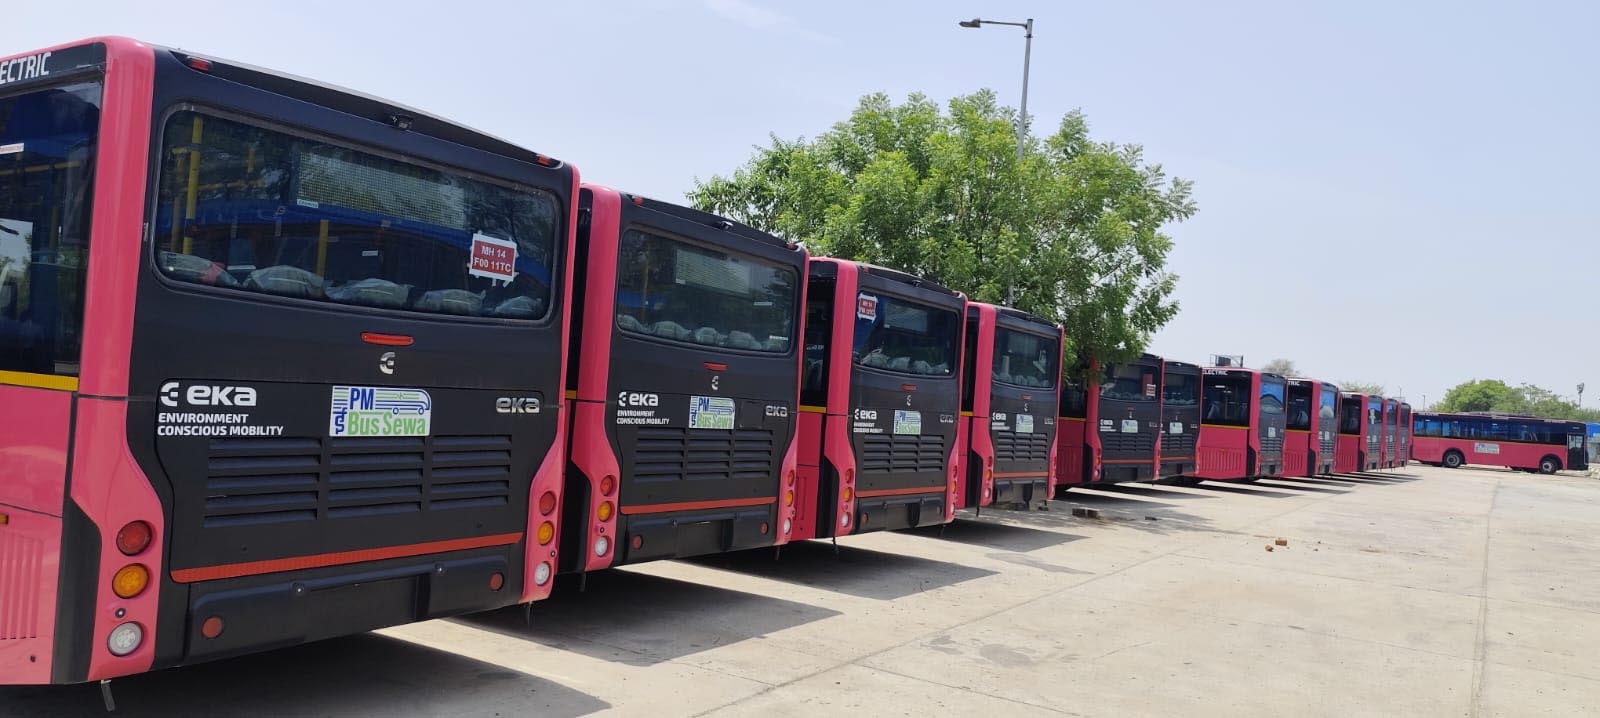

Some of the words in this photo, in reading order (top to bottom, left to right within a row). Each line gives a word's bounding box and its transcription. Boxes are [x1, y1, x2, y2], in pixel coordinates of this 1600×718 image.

[481, 245, 495, 256] MH
[497, 248, 506, 259] 14
[490, 260, 511, 272] 11TC
[186, 385, 257, 406] eka
[349, 387, 375, 410] PM
[629, 393, 659, 407] eka
[495, 397, 540, 413] eka
[699, 397, 711, 412] PM
[765, 405, 788, 417] eka
[157, 412, 249, 424] ENVIRONMENT
[616, 417, 645, 425] CONSCIOUS
[860, 410, 878, 420] eka
[347, 410, 380, 435] Bus
[382, 411, 426, 435] Sewa
[157, 425, 227, 436] CONSCIOUS
[229, 426, 284, 436] MOBILITY
